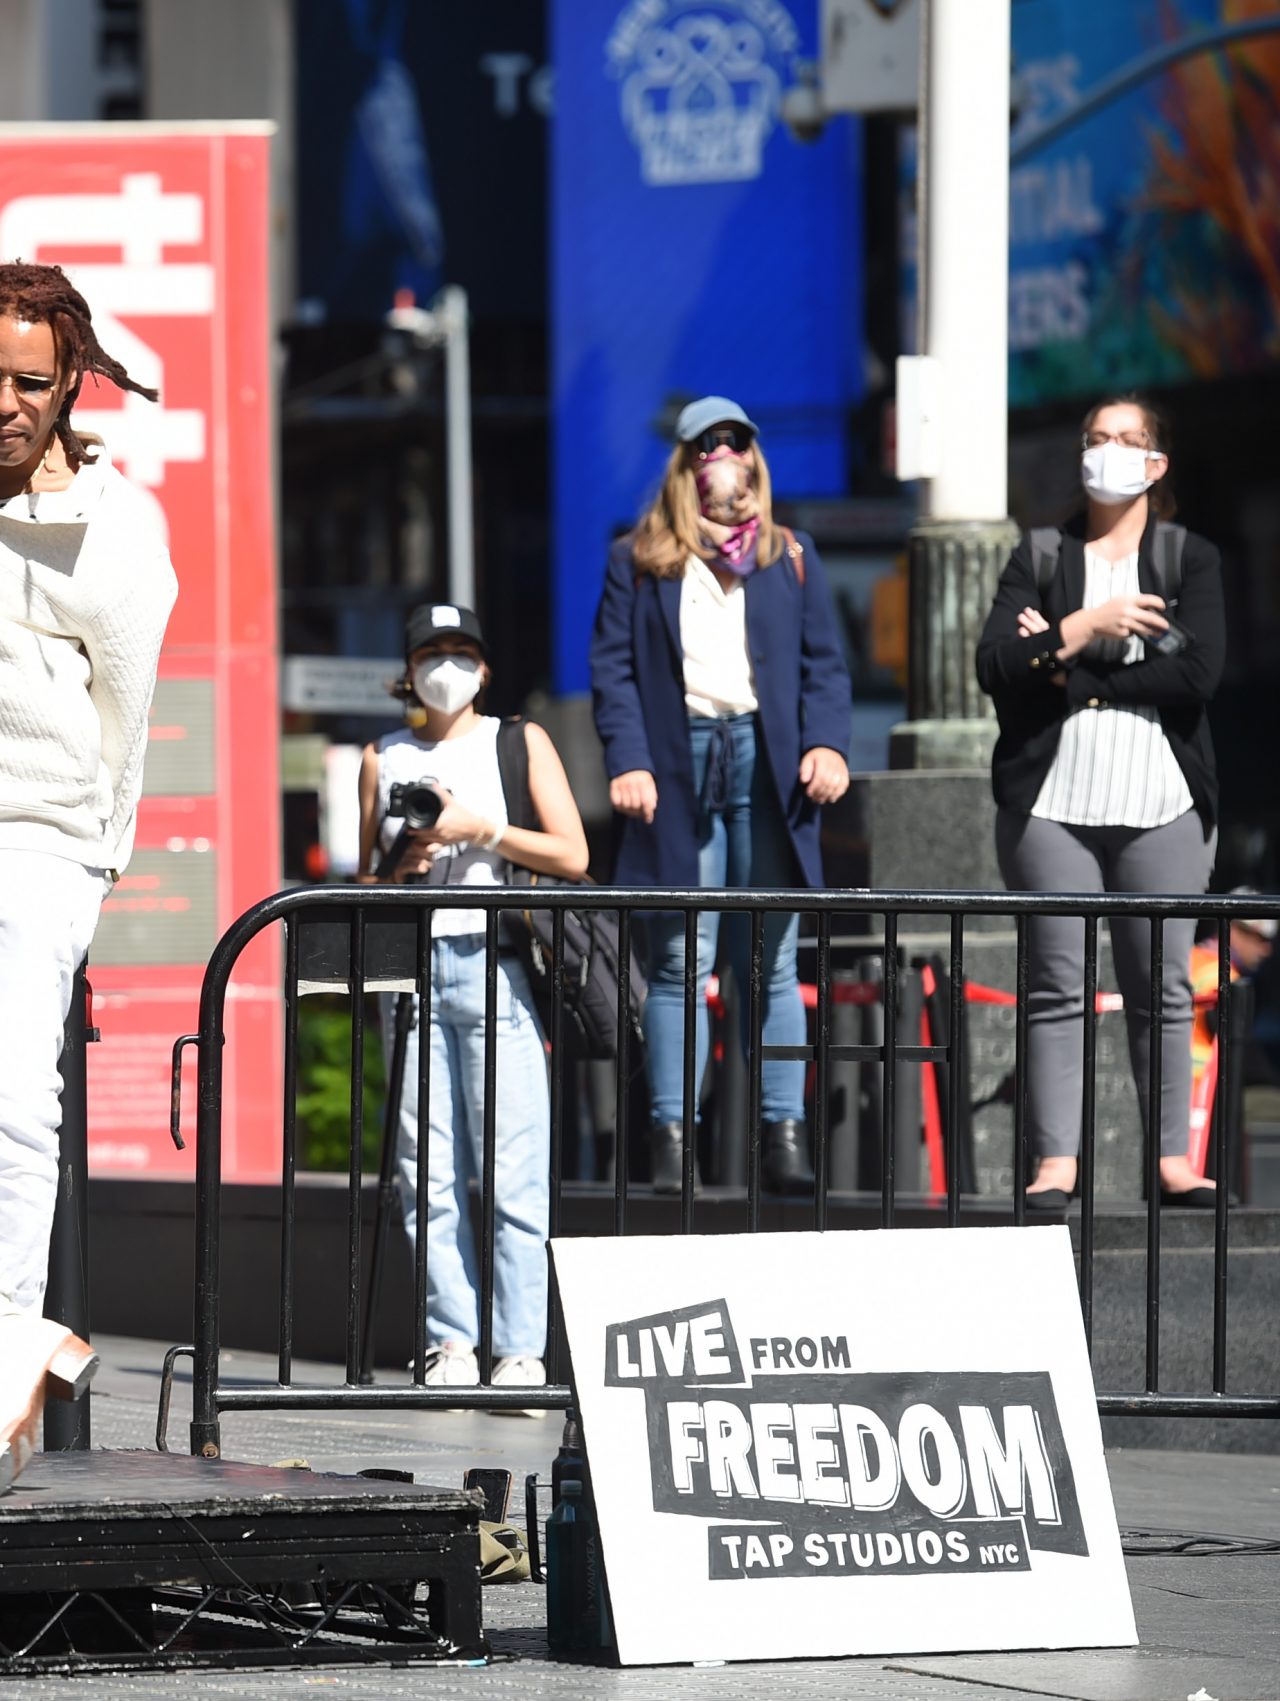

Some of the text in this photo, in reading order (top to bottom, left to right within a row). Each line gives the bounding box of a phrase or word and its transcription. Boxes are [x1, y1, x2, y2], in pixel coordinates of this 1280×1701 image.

[616, 1311, 852, 1378] LIVE FROM
[666, 1399, 1062, 1525] FREEDOM
[584, 1535, 596, 1601] WAIAKEA
[721, 1530, 1020, 1569] TAP STUDIOS NYC
